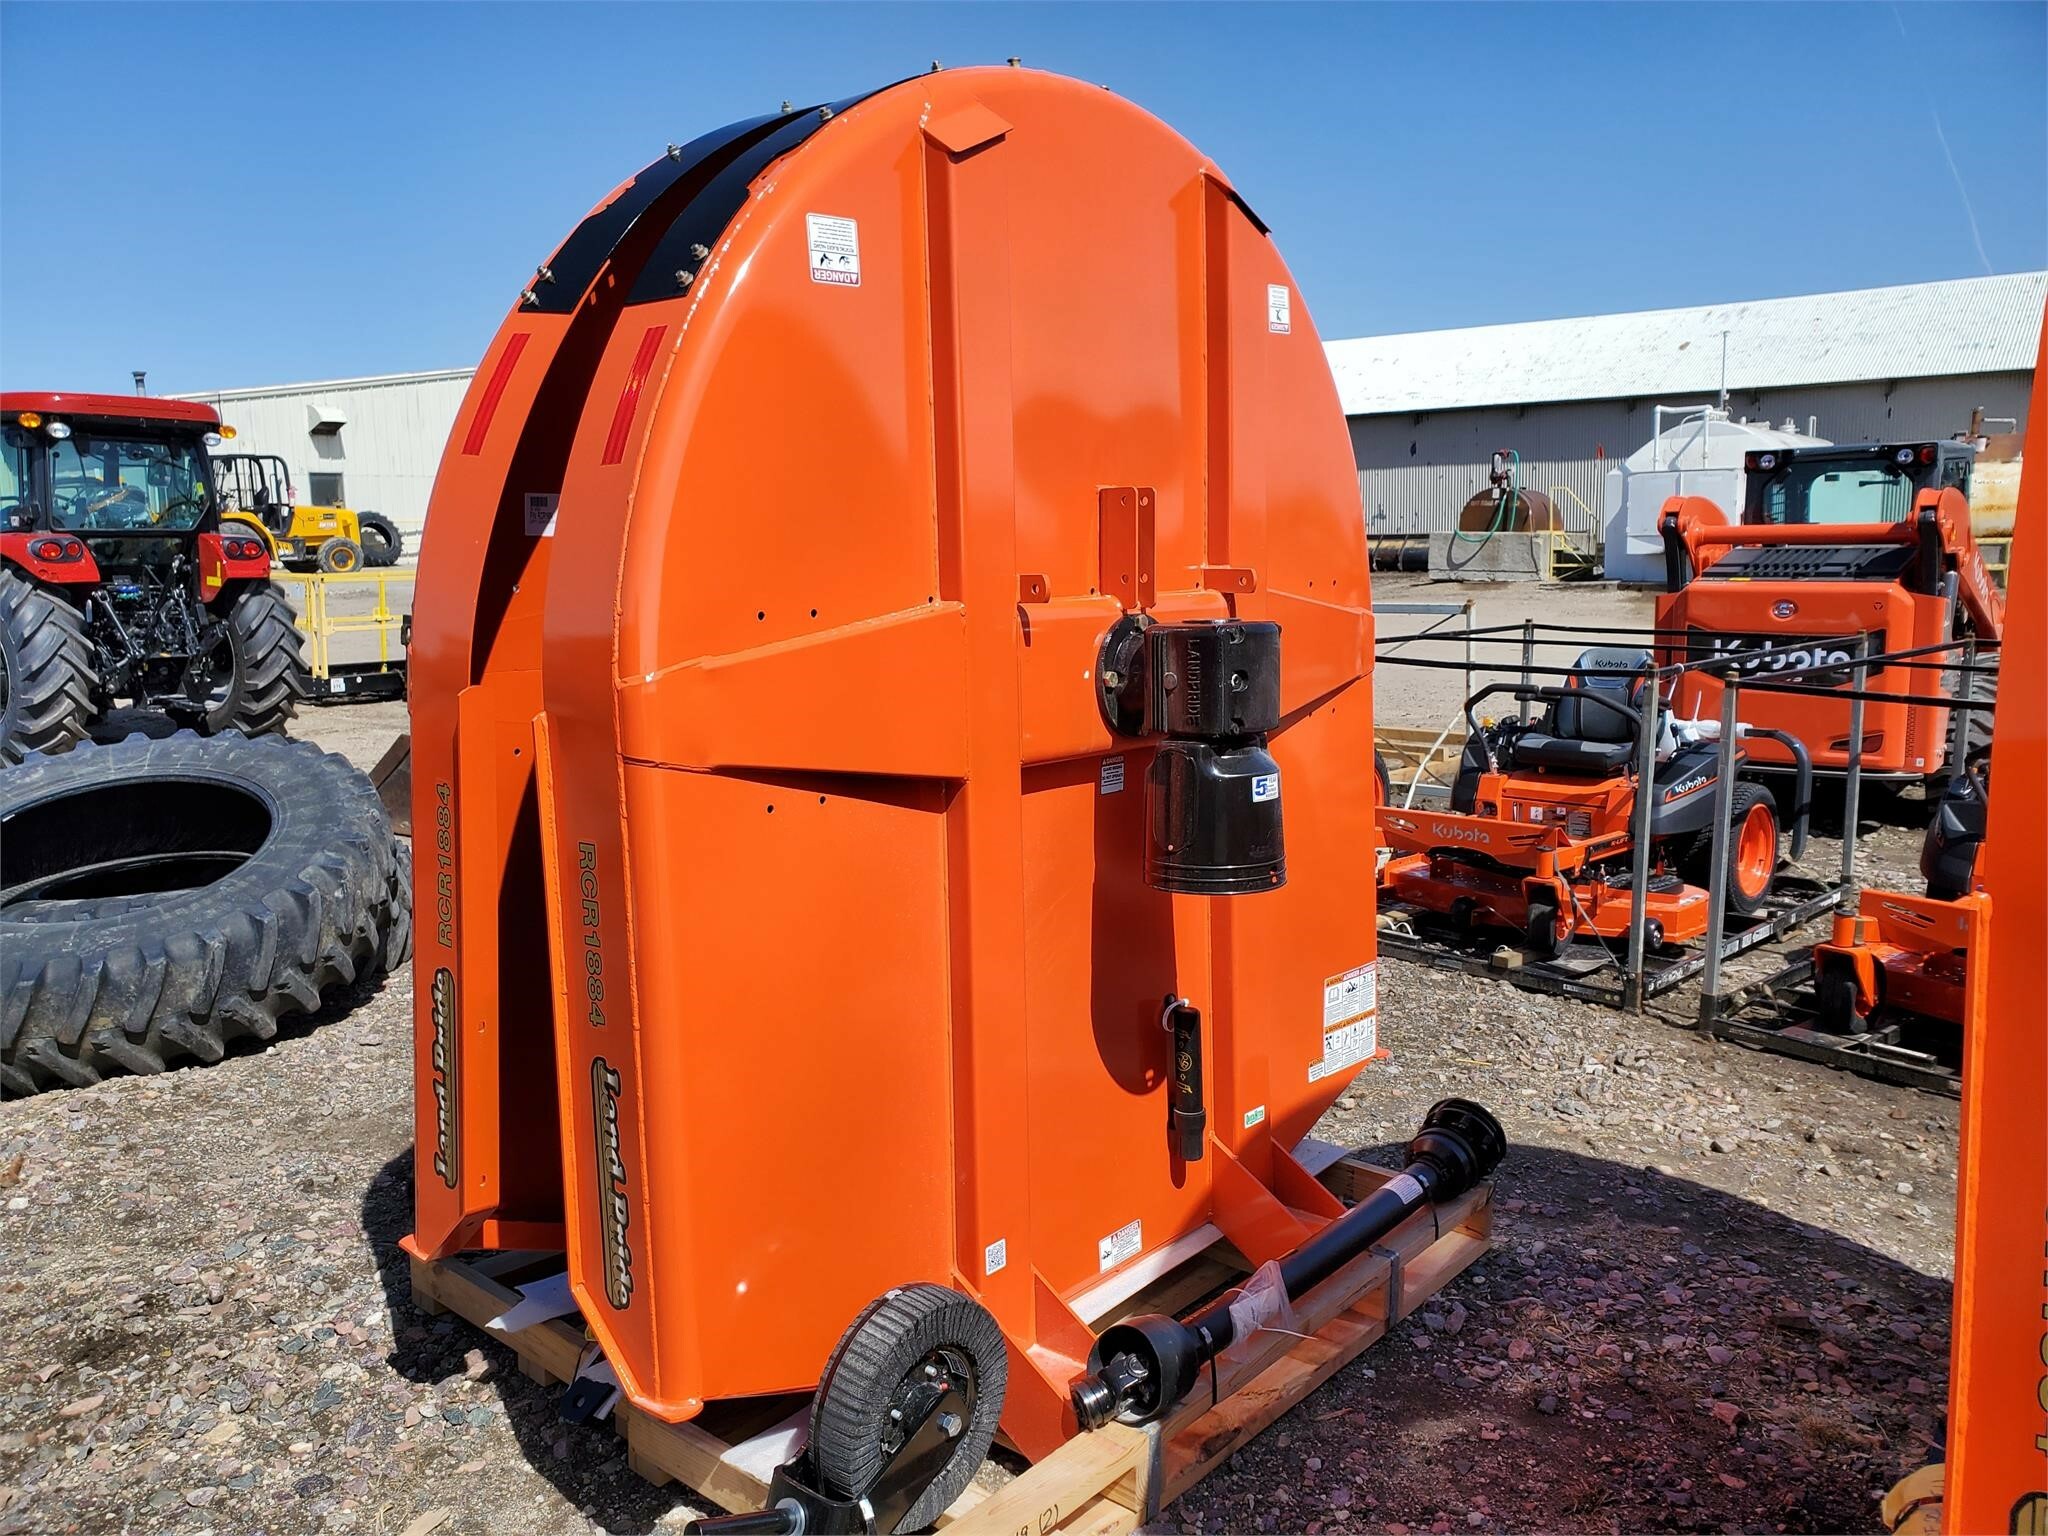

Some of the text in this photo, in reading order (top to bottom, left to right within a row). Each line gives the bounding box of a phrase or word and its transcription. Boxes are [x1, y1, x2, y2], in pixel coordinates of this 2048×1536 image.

[813, 269, 851, 283] DANGER
[1595, 659, 1629, 669] Kubota
[1255, 777, 1268, 796] 5
[1674, 775, 1707, 793] Kubota
[1432, 822, 1490, 844] Kubota
[437, 783, 452, 949] RCR1884
[578, 842, 606, 1028] RCR1884
[431, 967, 453, 1185] Land Pride
[601, 1064, 635, 1309] Land Pride
